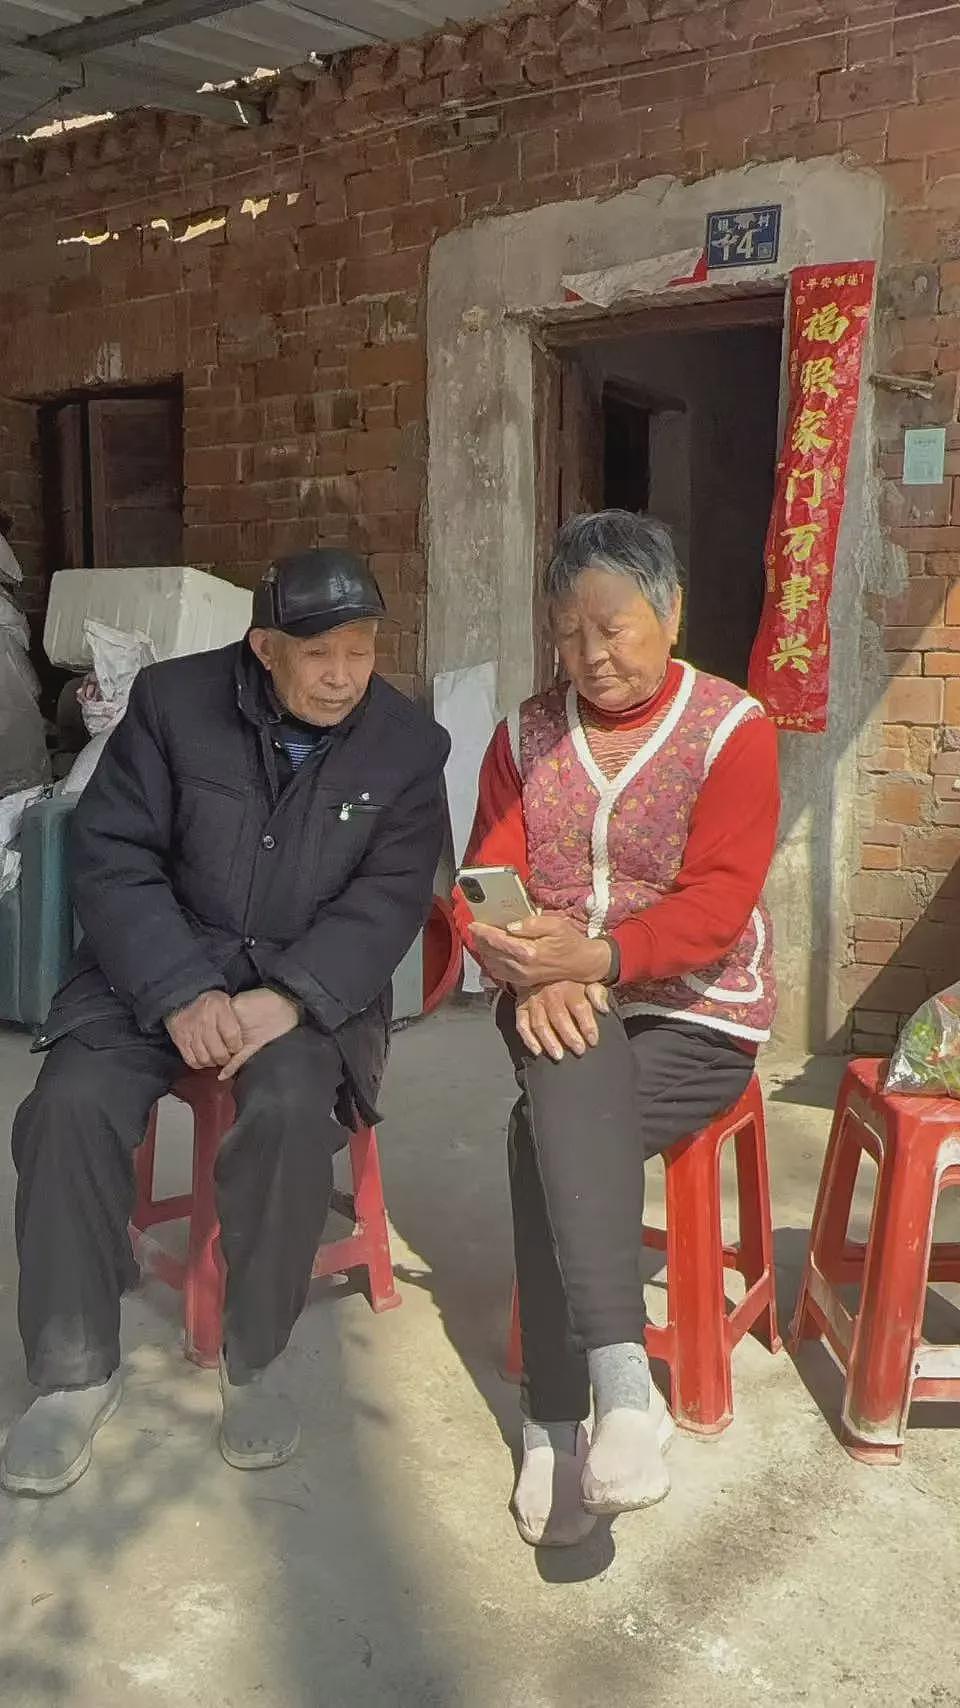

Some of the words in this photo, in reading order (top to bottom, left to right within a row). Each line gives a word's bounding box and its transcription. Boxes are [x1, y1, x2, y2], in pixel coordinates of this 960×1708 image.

[720, 230, 754, 261] 14
[768, 302, 850, 674] 福照家门万事兴
